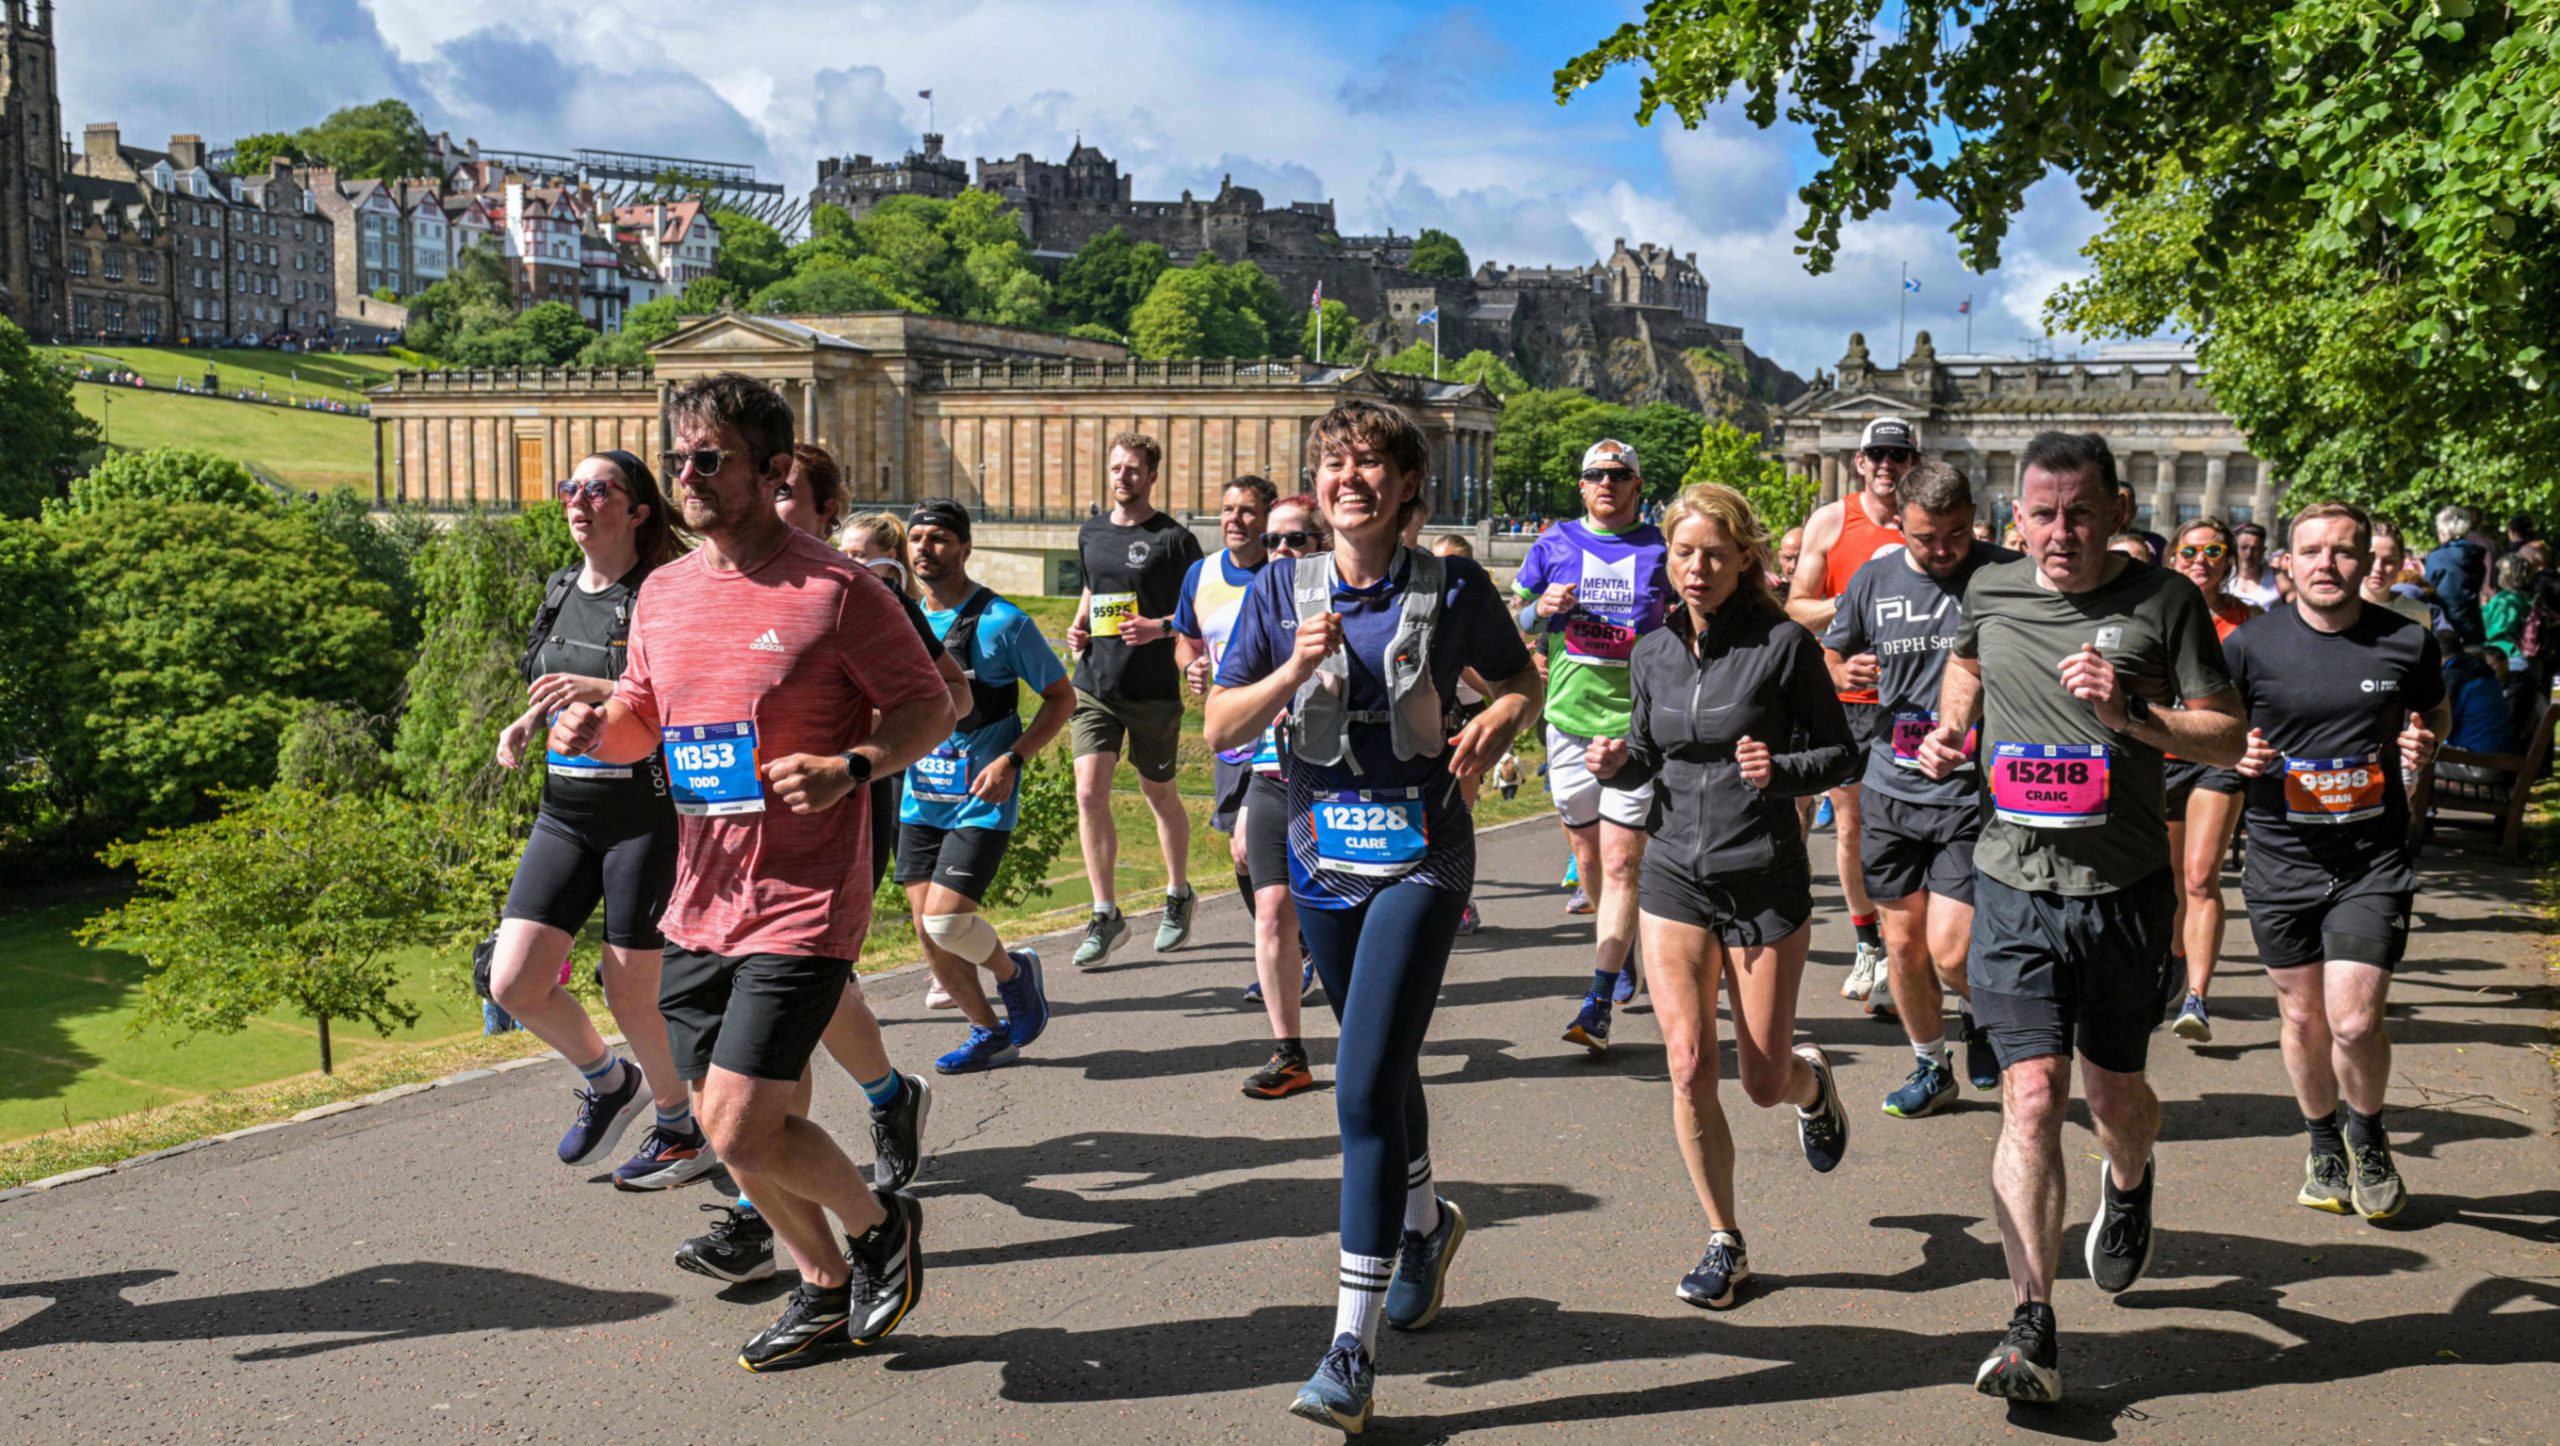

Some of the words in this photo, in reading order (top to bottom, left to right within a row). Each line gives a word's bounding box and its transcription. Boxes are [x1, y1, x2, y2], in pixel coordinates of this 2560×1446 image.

[1583, 577, 1632, 591] MENTAL
[1581, 589, 1632, 602] HEALTH
[1580, 602, 1633, 614] FOUNDATION
[749, 642, 785, 652] adidas
[1883, 636, 1927, 656] DFPH
[673, 742, 736, 771] 11353
[2006, 760, 2090, 785] 15218
[688, 775, 721, 789] TODD
[2300, 769, 2369, 791] 9998
[2025, 790, 2069, 802] CRAIG
[2320, 793, 2352, 805] SEAN
[1322, 805, 1408, 831] 12328
[1345, 836, 1388, 849] CLARE
